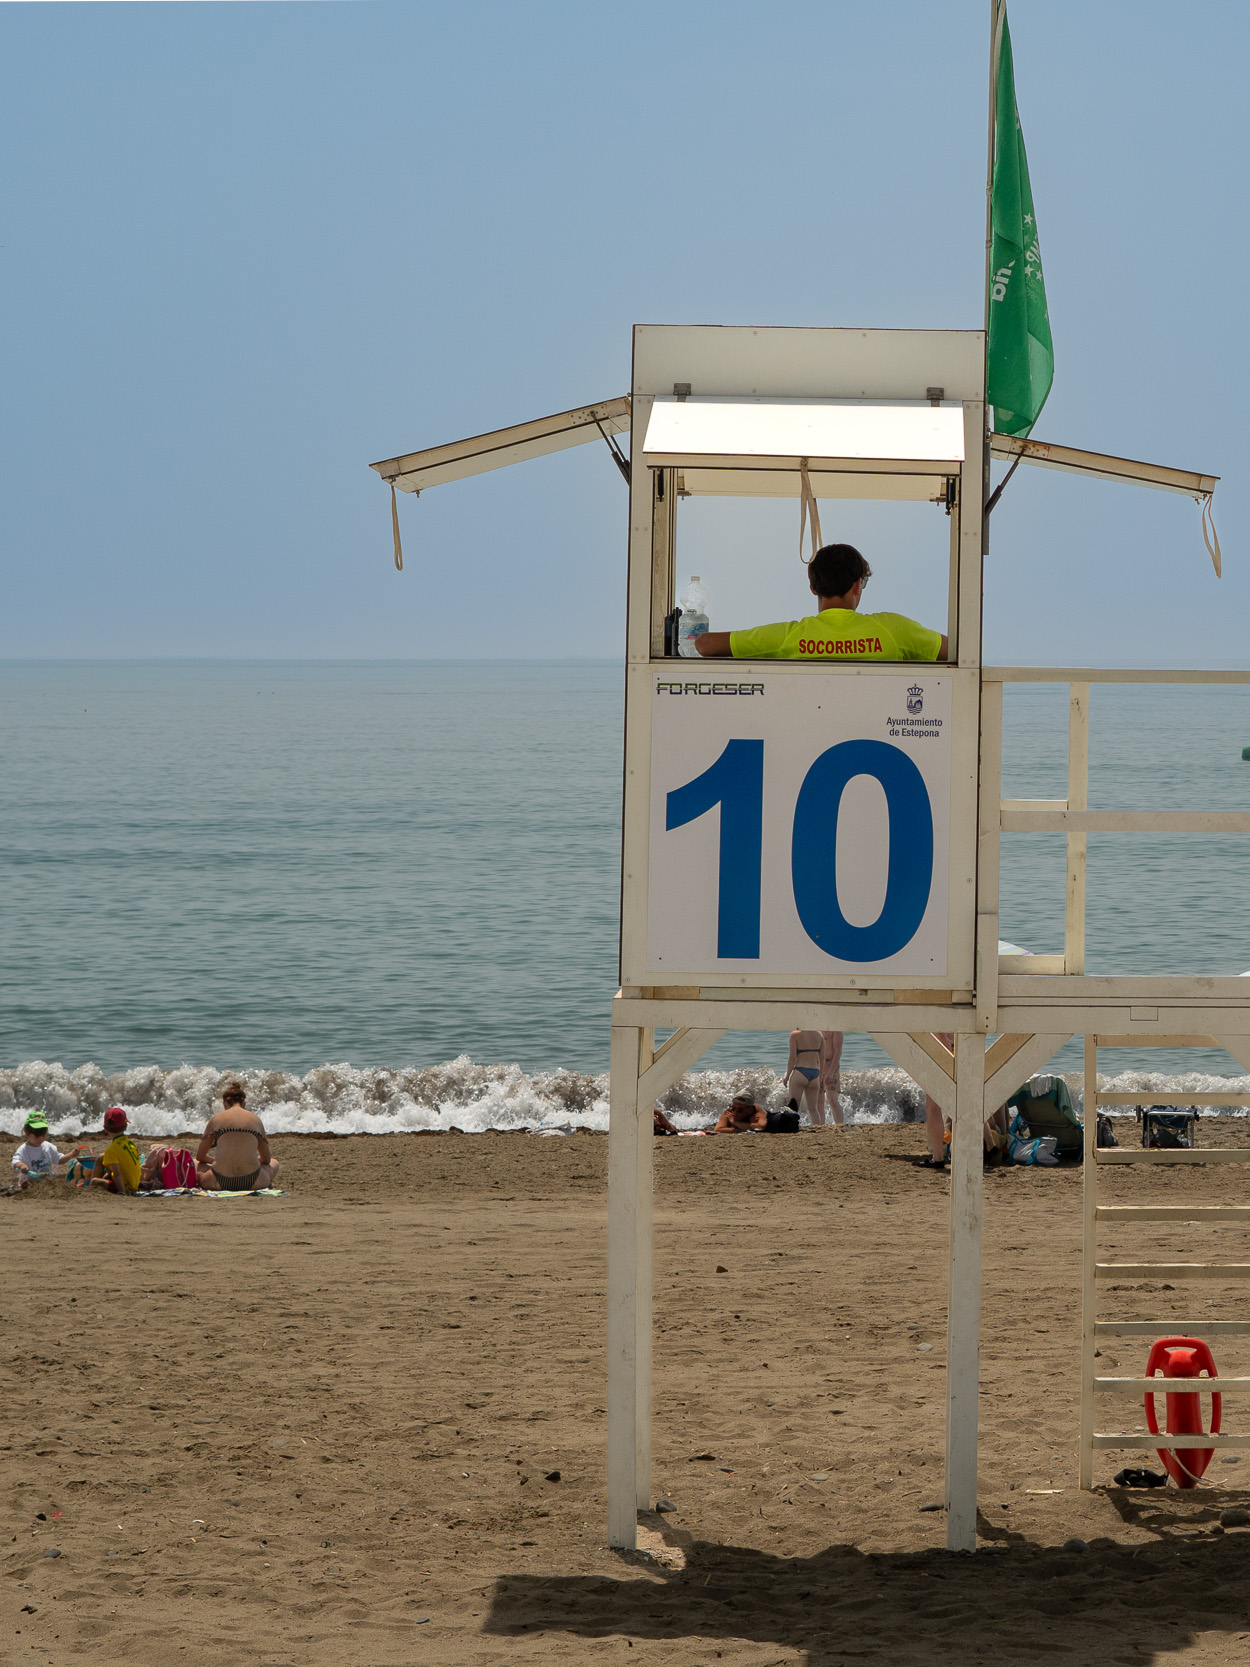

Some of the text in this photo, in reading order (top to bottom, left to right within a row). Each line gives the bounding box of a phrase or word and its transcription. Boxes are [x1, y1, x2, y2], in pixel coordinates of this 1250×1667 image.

[798, 637, 883, 655] SOCORRISTA
[656, 682, 765, 696] FORGESER
[886, 717, 943, 728] Ayuntamiento
[889, 728, 940, 738] de Estepona
[665, 739, 934, 963] 10
